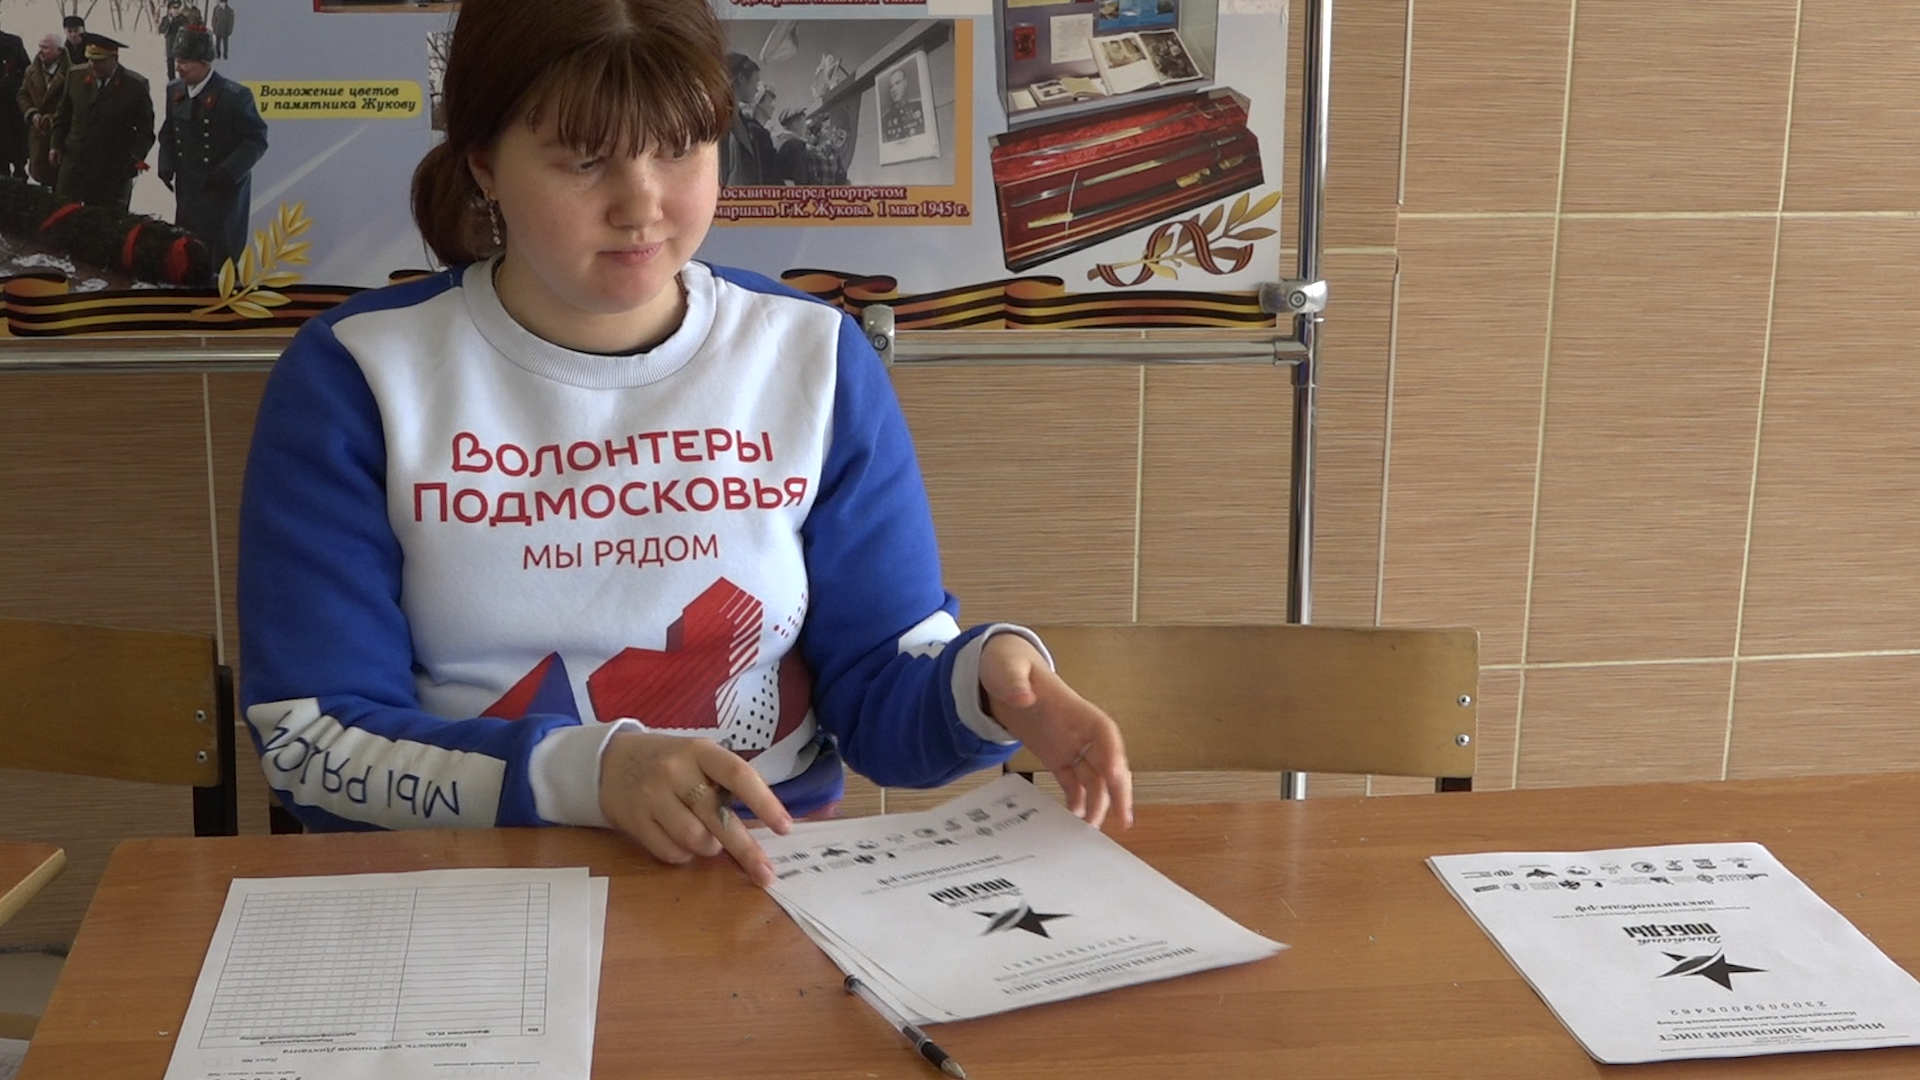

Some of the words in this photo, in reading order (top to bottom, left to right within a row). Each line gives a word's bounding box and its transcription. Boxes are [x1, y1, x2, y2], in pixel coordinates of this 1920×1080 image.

[260, 85, 344, 97] Возложение
[349, 87, 399, 98] цветов
[260, 101, 269, 112] у
[274, 100, 356, 110] памятника
[361, 98, 416, 112] Жукову
[718, 187, 781, 199] осквичи
[787, 188, 825, 200] перед
[831, 187, 906, 201] портретом
[714, 204, 775, 219] маршала
[814, 202, 872, 220] Жукова.
[878, 202, 886, 216] 1
[889, 206, 916, 216] мая
[921, 202, 952, 216] 1945
[955, 205, 969, 217] г.
[523, 542, 582, 570] МЫ
[594, 533, 719, 569] РЯДОМ
[387, 769, 460, 818] МЫ
[1621, 922, 1718, 938] ПОБЕДЫ
